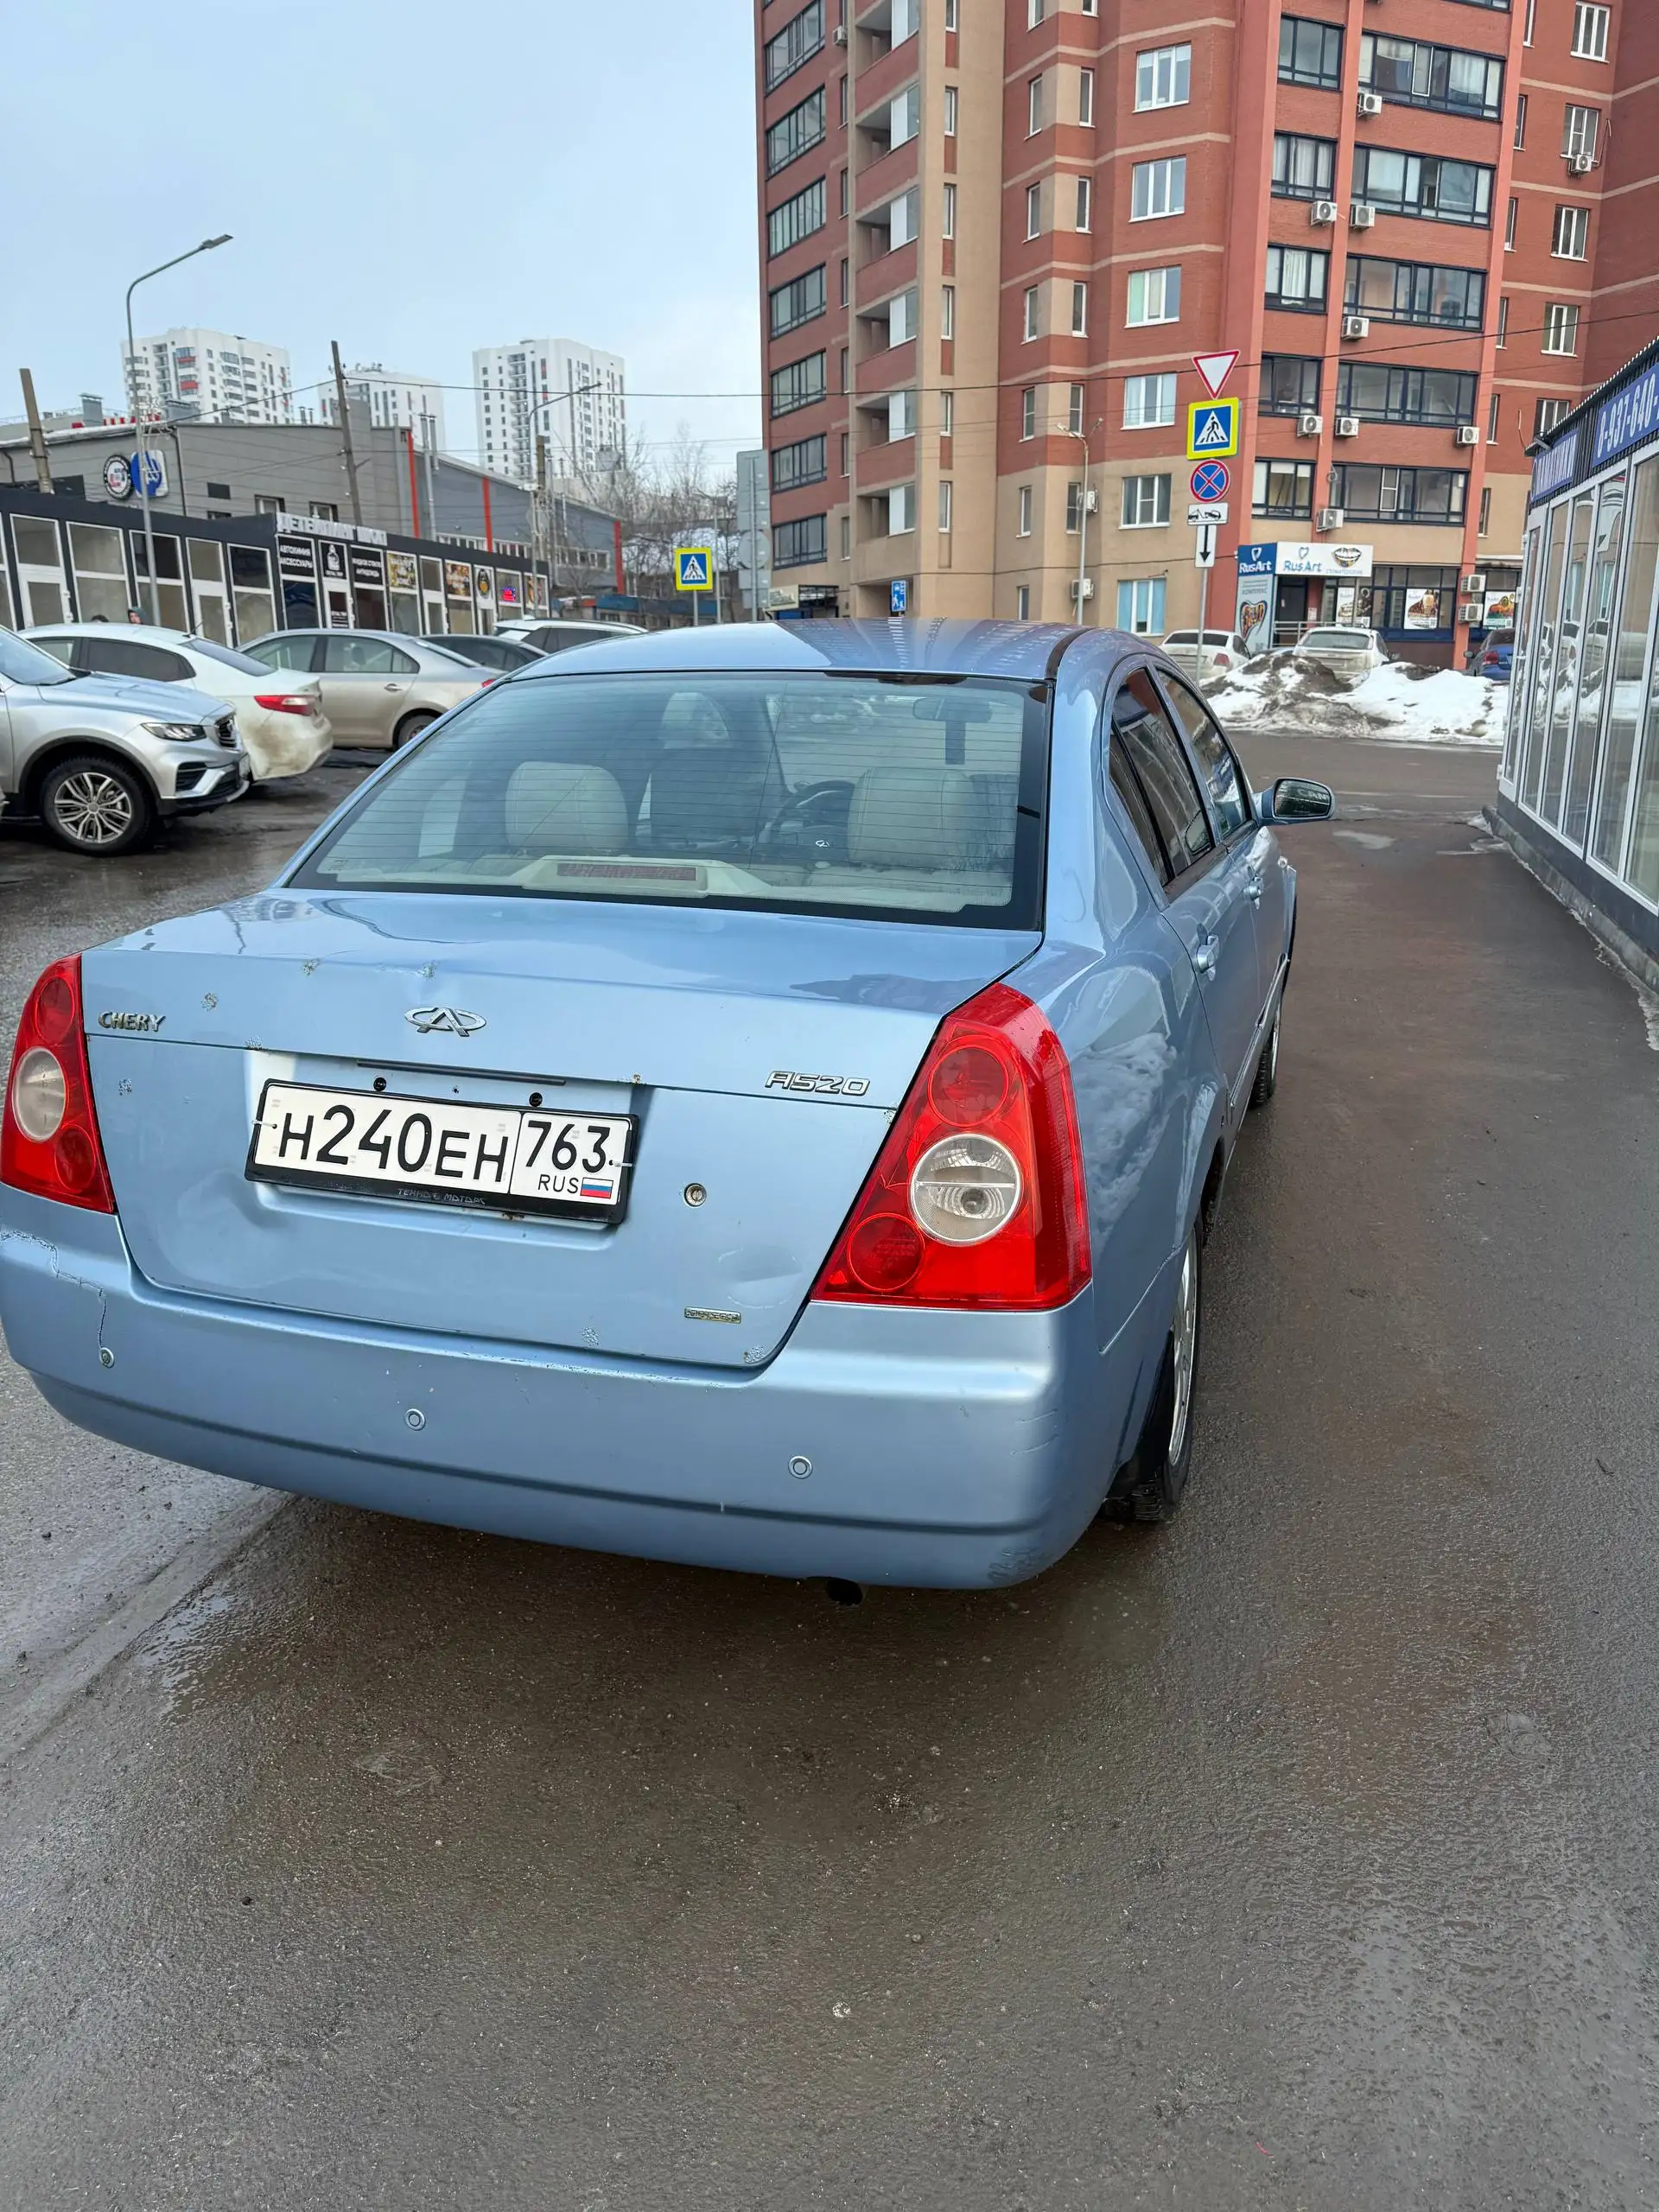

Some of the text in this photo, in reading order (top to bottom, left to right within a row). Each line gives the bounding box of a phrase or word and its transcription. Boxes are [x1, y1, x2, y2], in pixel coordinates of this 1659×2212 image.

[1597, 372, 1659, 459] 8-937-640-
[1239, 561, 1272, 573] RusArt
[99, 1011, 166, 1032] CHERY
[765, 1071, 870, 1096] A520
[525, 1121, 611, 1173] 763
[538, 1174, 579, 1194] RUS
